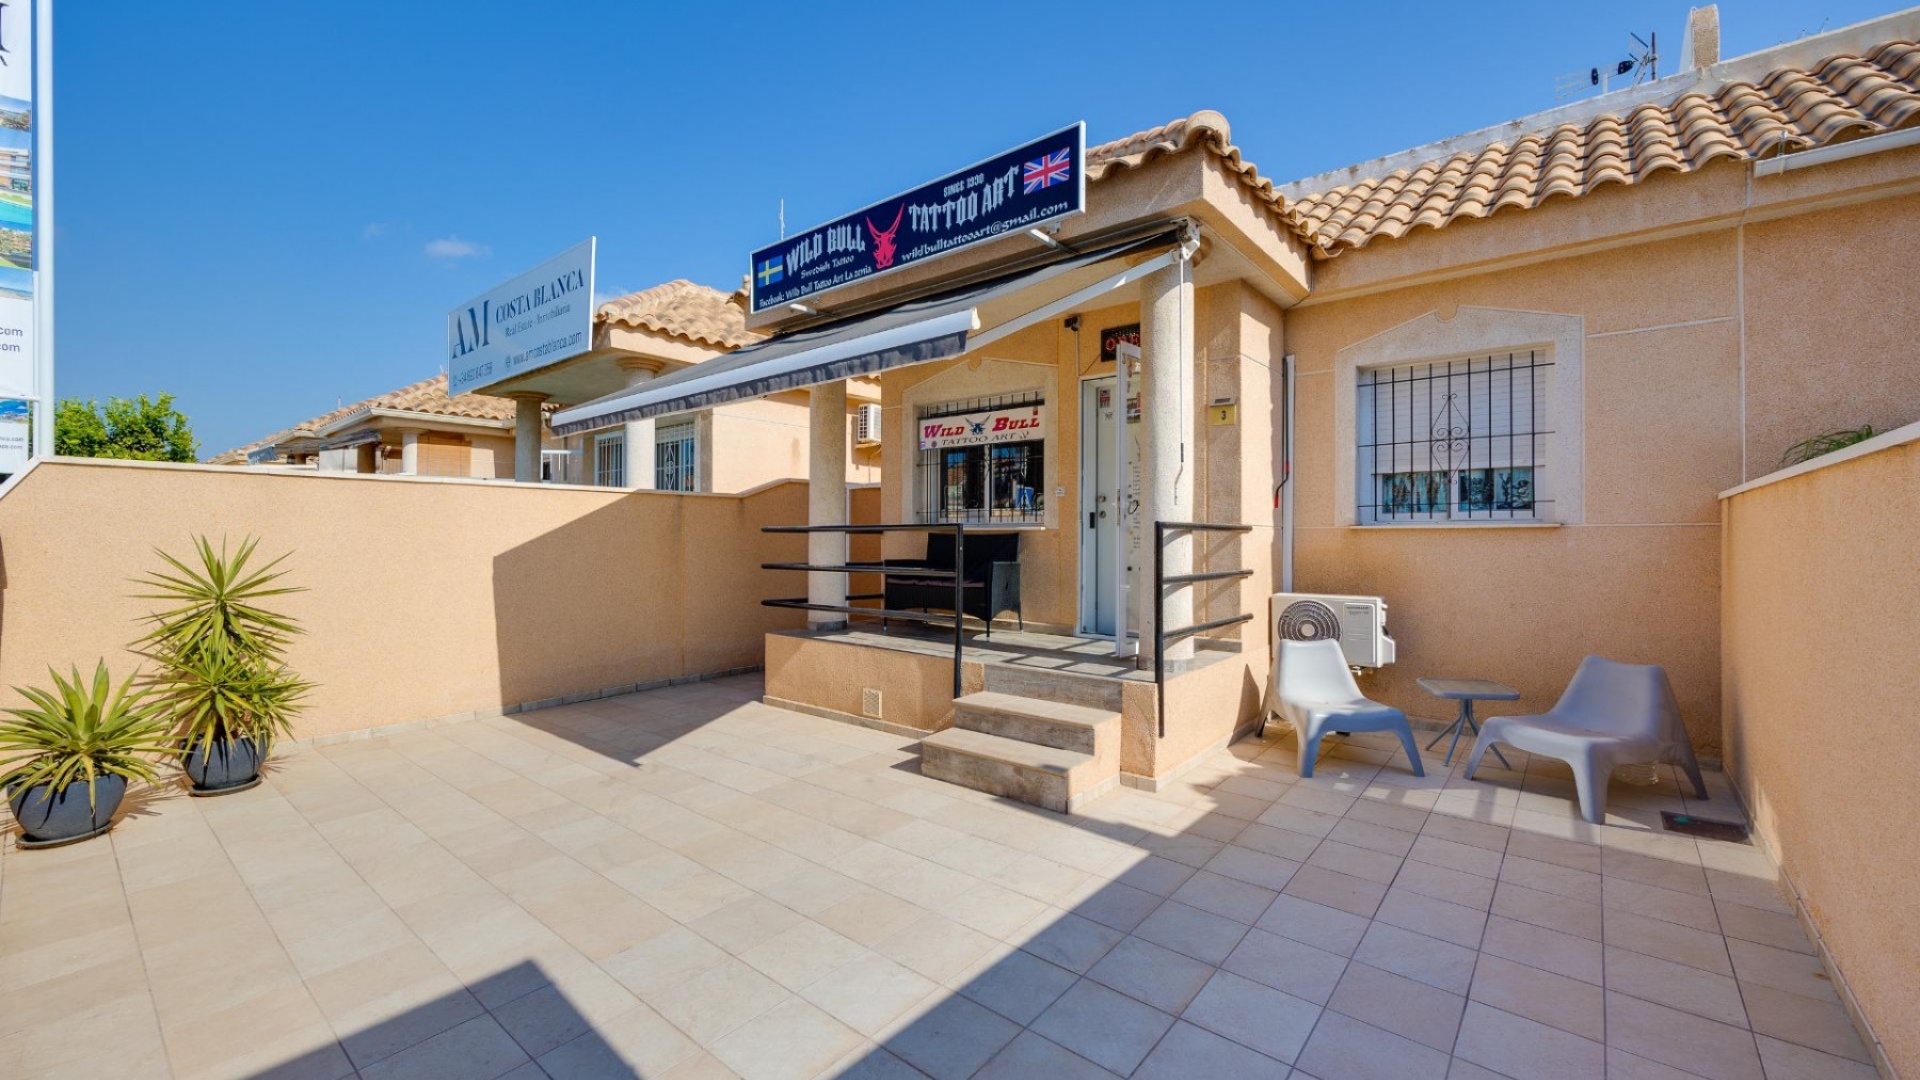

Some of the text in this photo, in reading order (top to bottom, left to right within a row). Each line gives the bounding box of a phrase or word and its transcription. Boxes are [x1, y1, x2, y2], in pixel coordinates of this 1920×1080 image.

[908, 164, 1020, 233] TATTOO ART
[944, 180, 964, 198] SINCE
[786, 223, 866, 277] WILD BULL
[901, 201, 1068, 262] wildbulltattooart@gmail.com
[496, 268, 585, 324] COSTA BLANCA
[800, 261, 830, 279] Swedish
[452, 299, 491, 359] AM
[941, 433, 1015, 446] TATTOO ART
[1221, 410, 1227, 421] 3
